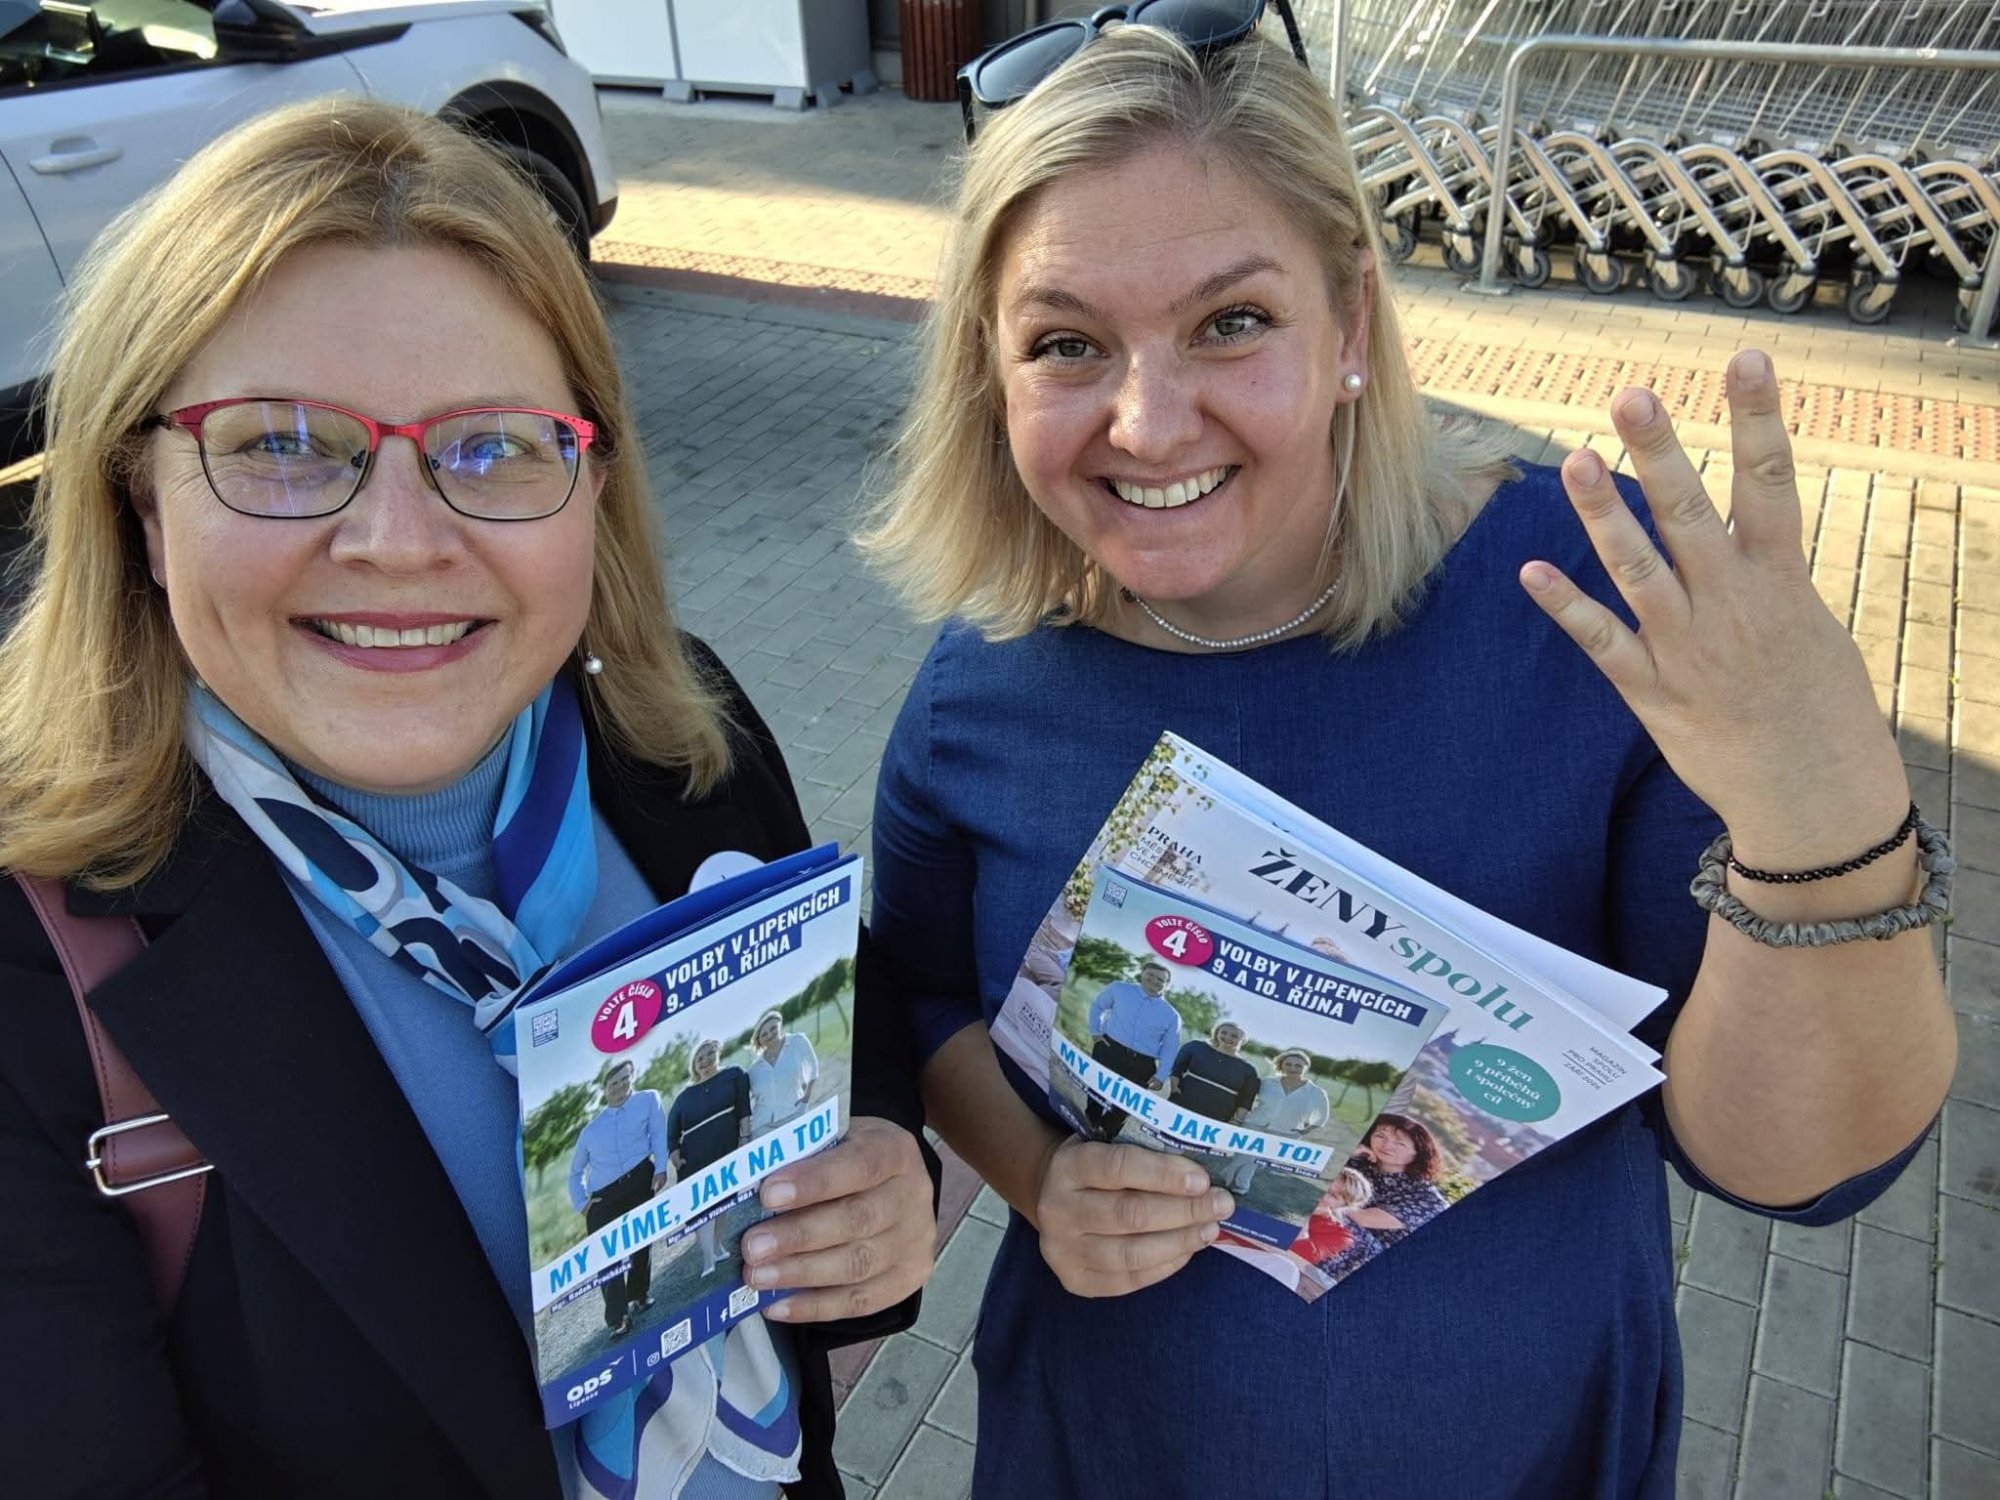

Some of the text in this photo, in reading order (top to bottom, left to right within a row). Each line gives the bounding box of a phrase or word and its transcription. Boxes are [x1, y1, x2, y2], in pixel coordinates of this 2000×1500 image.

[1148, 826, 1202, 864] PRAHA
[665, 886, 840, 991] VOLBY V LIPENCÍCH
[1155, 917, 1208, 945] VOLTE ČÍSLO
[1162, 928, 1187, 959] 4
[666, 934, 791, 1015] 9. A 10. ŘÍJNA
[1212, 959, 1344, 1018] 9. A 10. ŘÍJNA
[1218, 939, 1412, 1020] VOLBY V LIPENCÍCH
[598, 979, 656, 1022] VOLTE ČÍSLO
[612, 1000, 638, 1041] 4
[1507, 1063, 1532, 1082] žen
[1567, 1049, 1585, 1063] PRO
[1060, 1041, 1090, 1076] MY
[1097, 1070, 1160, 1125] VÍME,
[1168, 1113, 1222, 1144] JAK
[1228, 1132, 1264, 1154] NA
[1277, 1142, 1322, 1165] TO!
[1474, 1074, 1536, 1109] společný
[1484, 1067, 1540, 1100] příběhů
[550, 1109, 832, 1294] MY VÍME, JAK NA TO!
[566, 1369, 613, 1403] ODS
